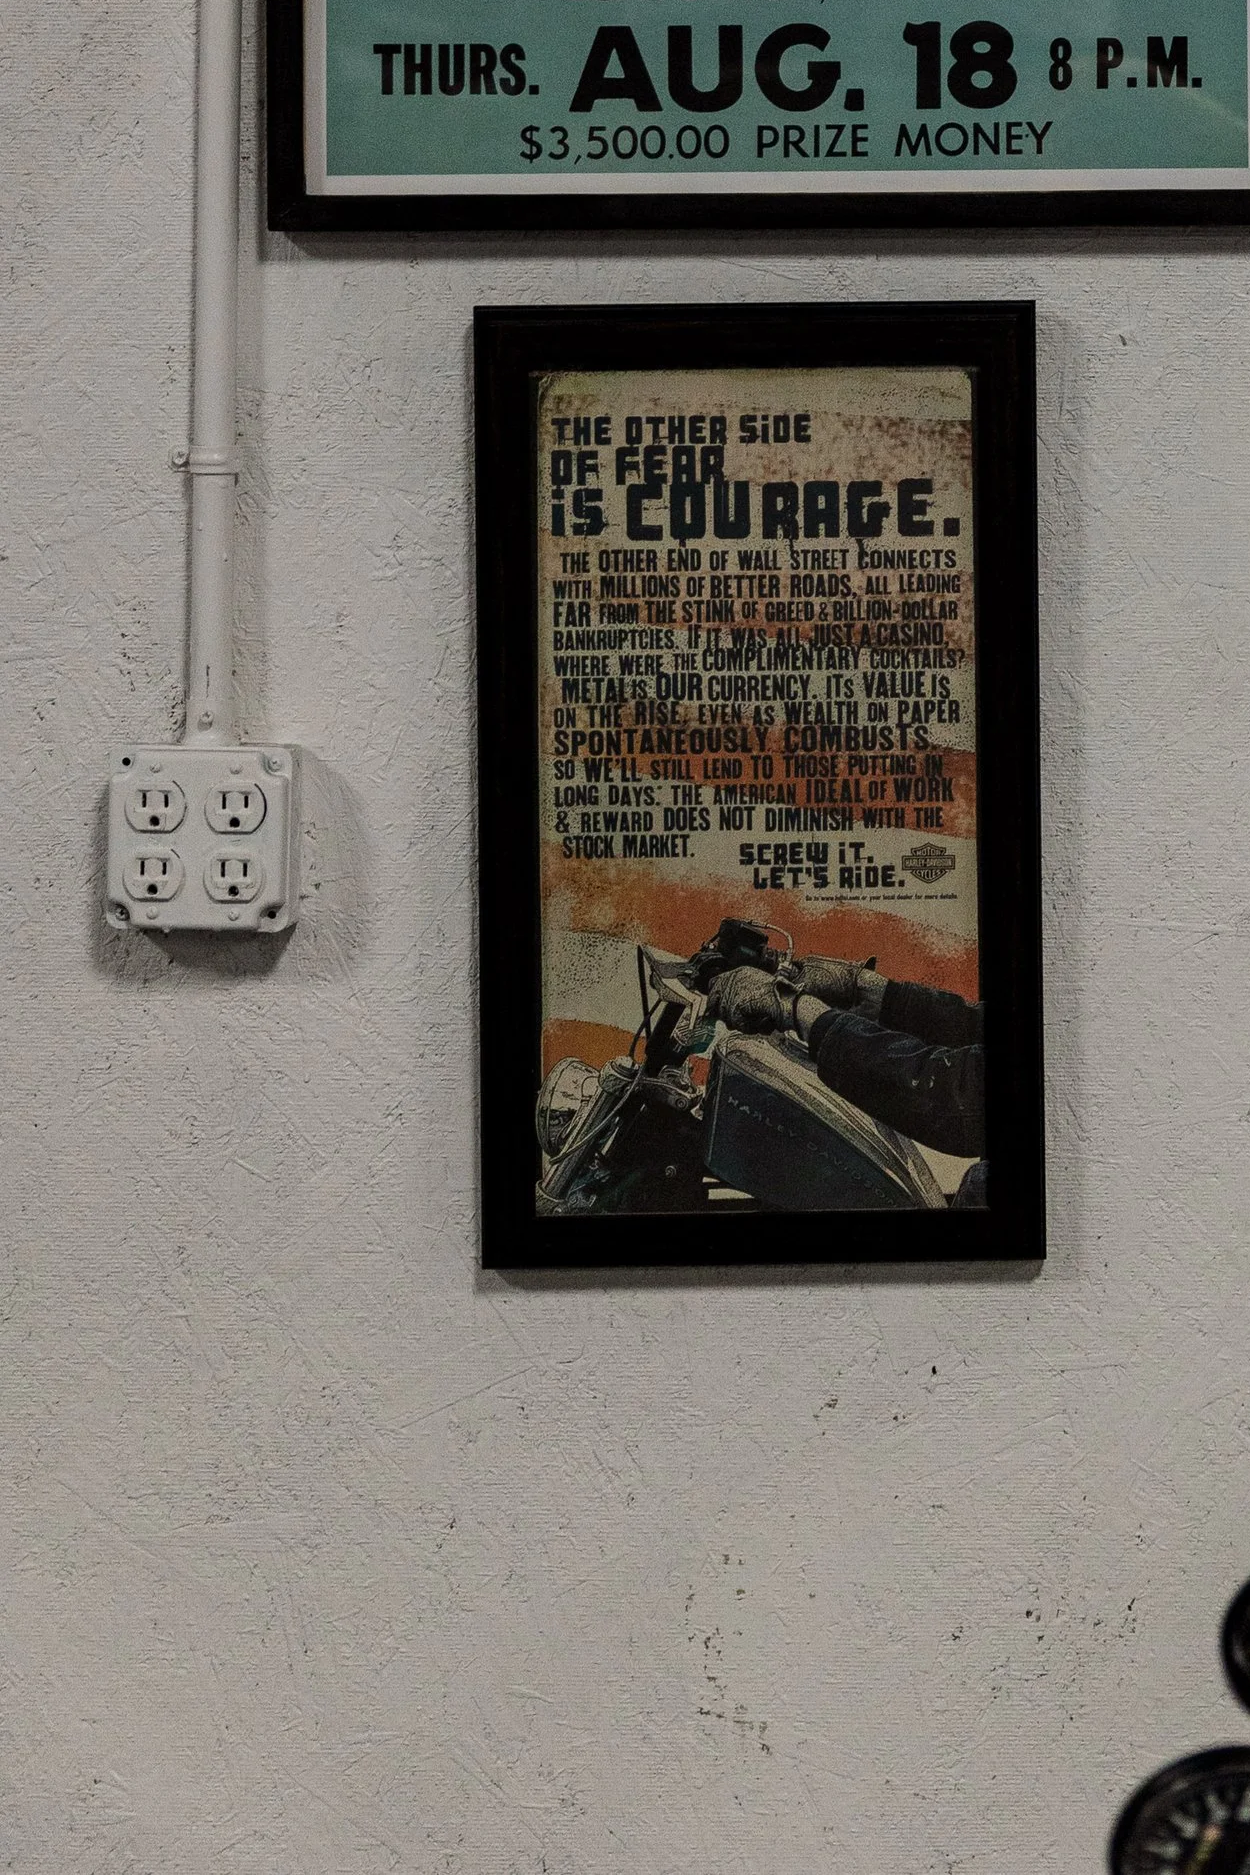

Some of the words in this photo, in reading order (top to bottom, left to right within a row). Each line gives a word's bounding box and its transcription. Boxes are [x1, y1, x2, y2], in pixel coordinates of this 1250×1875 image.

[373, 41, 540, 97] THURS.
[569, 23, 865, 114] AUG.
[902, 20, 1018, 111] 18
[1046, 37, 1070, 90] 8
[1096, 36, 1203, 90] P.M.
[519, 123, 729, 166] $3,500.00
[756, 123, 870, 160] PRIZE
[893, 120, 1054, 158] MONEY
[552, 416, 611, 445] THE
[626, 415, 726, 444] OTHER
[552, 450, 598, 485] OF
[616, 445, 724, 485] FEAR
[627, 479, 960, 540] COURAGE.
[560, 552, 590, 573] THE
[599, 549, 657, 572] OTHER
[667, 549, 701, 571] END
[710, 550, 729, 571] OF
[738, 550, 781, 571] WALL
[791, 549, 849, 570] STREET
[858, 549, 957, 569] CONNECTS
[553, 580, 591, 599] WITH
[600, 575, 680, 598] MILLIONS
[686, 576, 705, 597] OF
[710, 575, 780, 598] BETTER
[791, 574, 857, 599] ROADS,
[865, 576, 891, 595] ALL
[899, 574, 960, 594] LEADING
[553, 602, 590, 627] FAR
[599, 603, 638, 624] FROM
[645, 600, 676, 623] THE
[682, 600, 734, 623] STINK
[741, 601, 758, 619] OF
[765, 602, 814, 622] GREED
[819, 603, 828, 621] &
[833, 599, 958, 622] BILLION-DOLLAR
[553, 629, 679, 651] BANKRUPTCIES.
[687, 625, 701, 649] IF
[706, 628, 720, 650] IT
[731, 628, 766, 649] WAS
[776, 627, 800, 649] ALL
[810, 624, 854, 646] JUST
[859, 624, 870, 648] A
[877, 623, 949, 648] CASINO,
[554, 655, 608, 676] WHERE
[619, 655, 663, 675] WERE
[673, 653, 697, 671] THE
[702, 647, 859, 672] COMPLIMENTARY
[870, 648, 965, 669] COCKTAILS?
[562, 678, 628, 703] METAL
[656, 673, 702, 701] OUR
[708, 675, 817, 701] CURRENCY.
[863, 672, 925, 698] VALUE
[554, 707, 576, 728] ON
[587, 705, 622, 728] THE
[699, 705, 742, 725] EVEN
[753, 705, 775, 725] AS
[785, 701, 858, 725] WEALTH
[867, 702, 888, 722] ON
[898, 700, 960, 723] PAPER
[554, 727, 769, 756] SPONTANEOUSLY
[554, 759, 575, 780] SO
[584, 757, 642, 782] WE'LL
[650, 759, 694, 780] STILL
[703, 758, 742, 779] LEND
[751, 755, 773, 779] TO
[783, 755, 839, 778] THOSE
[848, 755, 916, 776] PUTTING
[924, 754, 944, 776] IN
[554, 786, 599, 807] LONG
[671, 785, 703, 805] THE
[713, 785, 796, 805] AMERICAN
[806, 779, 863, 803] IDEAL
[868, 781, 887, 800] OF
[894, 777, 954, 803] WORK
[555, 811, 569, 833] &
[581, 811, 653, 833] REWARD
[664, 807, 710, 831] DOES
[719, 806, 755, 831] NOT
[765, 807, 853, 832] DIMINISH
[863, 807, 905, 829] WITH
[914, 807, 944, 828] THE
[562, 836, 614, 859] STOCK
[623, 834, 695, 858] MARKET.
[740, 842, 828, 865] SCREW
[754, 867, 828, 889] LET'S
